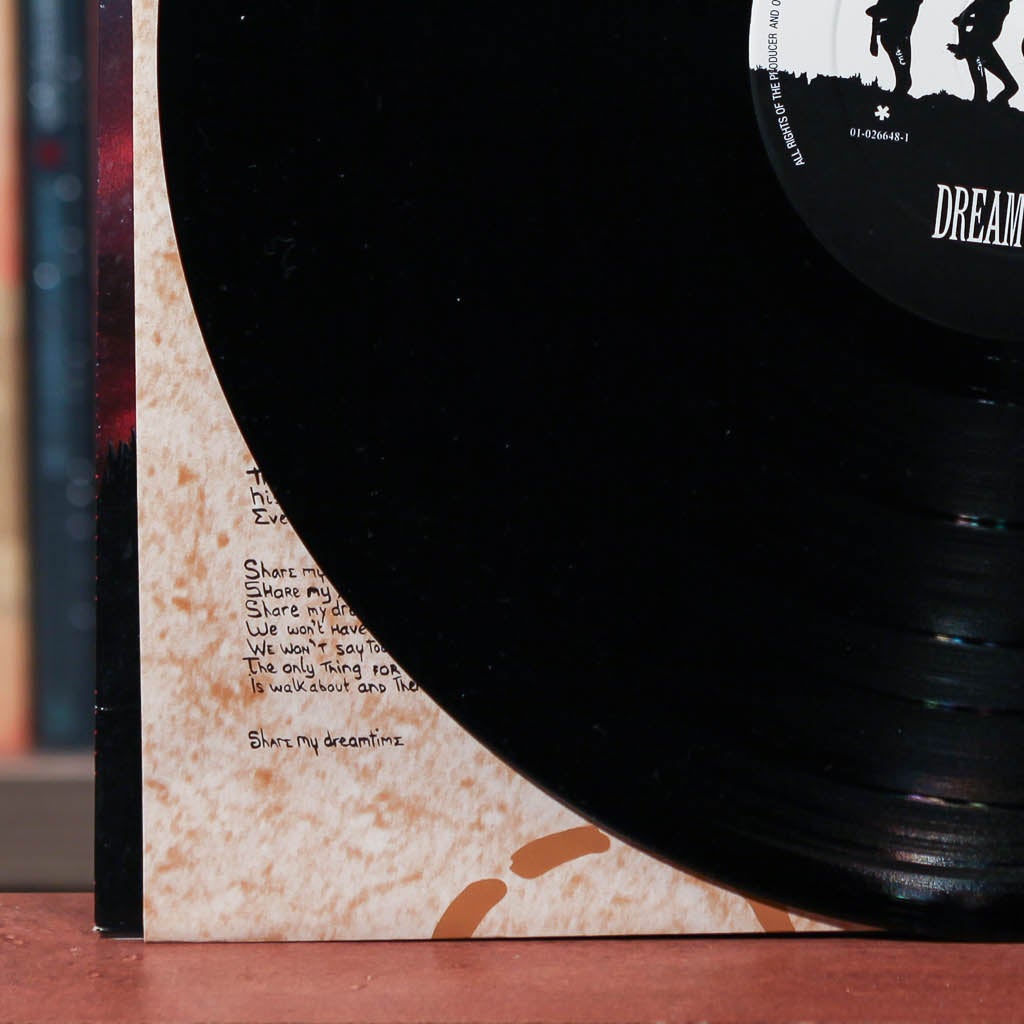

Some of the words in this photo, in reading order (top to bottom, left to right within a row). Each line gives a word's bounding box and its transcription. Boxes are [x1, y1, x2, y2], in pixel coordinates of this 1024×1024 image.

[769, 9, 781, 29] AND
[770, 81, 783, 101] THE
[774, 103, 787, 116] OF
[778, 115, 797, 150] RIGHTS
[849, 127, 909, 143] 01-026648-1
[791, 148, 806, 166] ALL
[306, 586, 332, 604] my
[245, 599, 300, 618] Share
[307, 606, 327, 623] my
[245, 620, 278, 637] We
[336, 643, 364, 663] say
[242, 657, 278, 675] The
[282, 656, 316, 679] only
[297, 733, 319, 756] my
